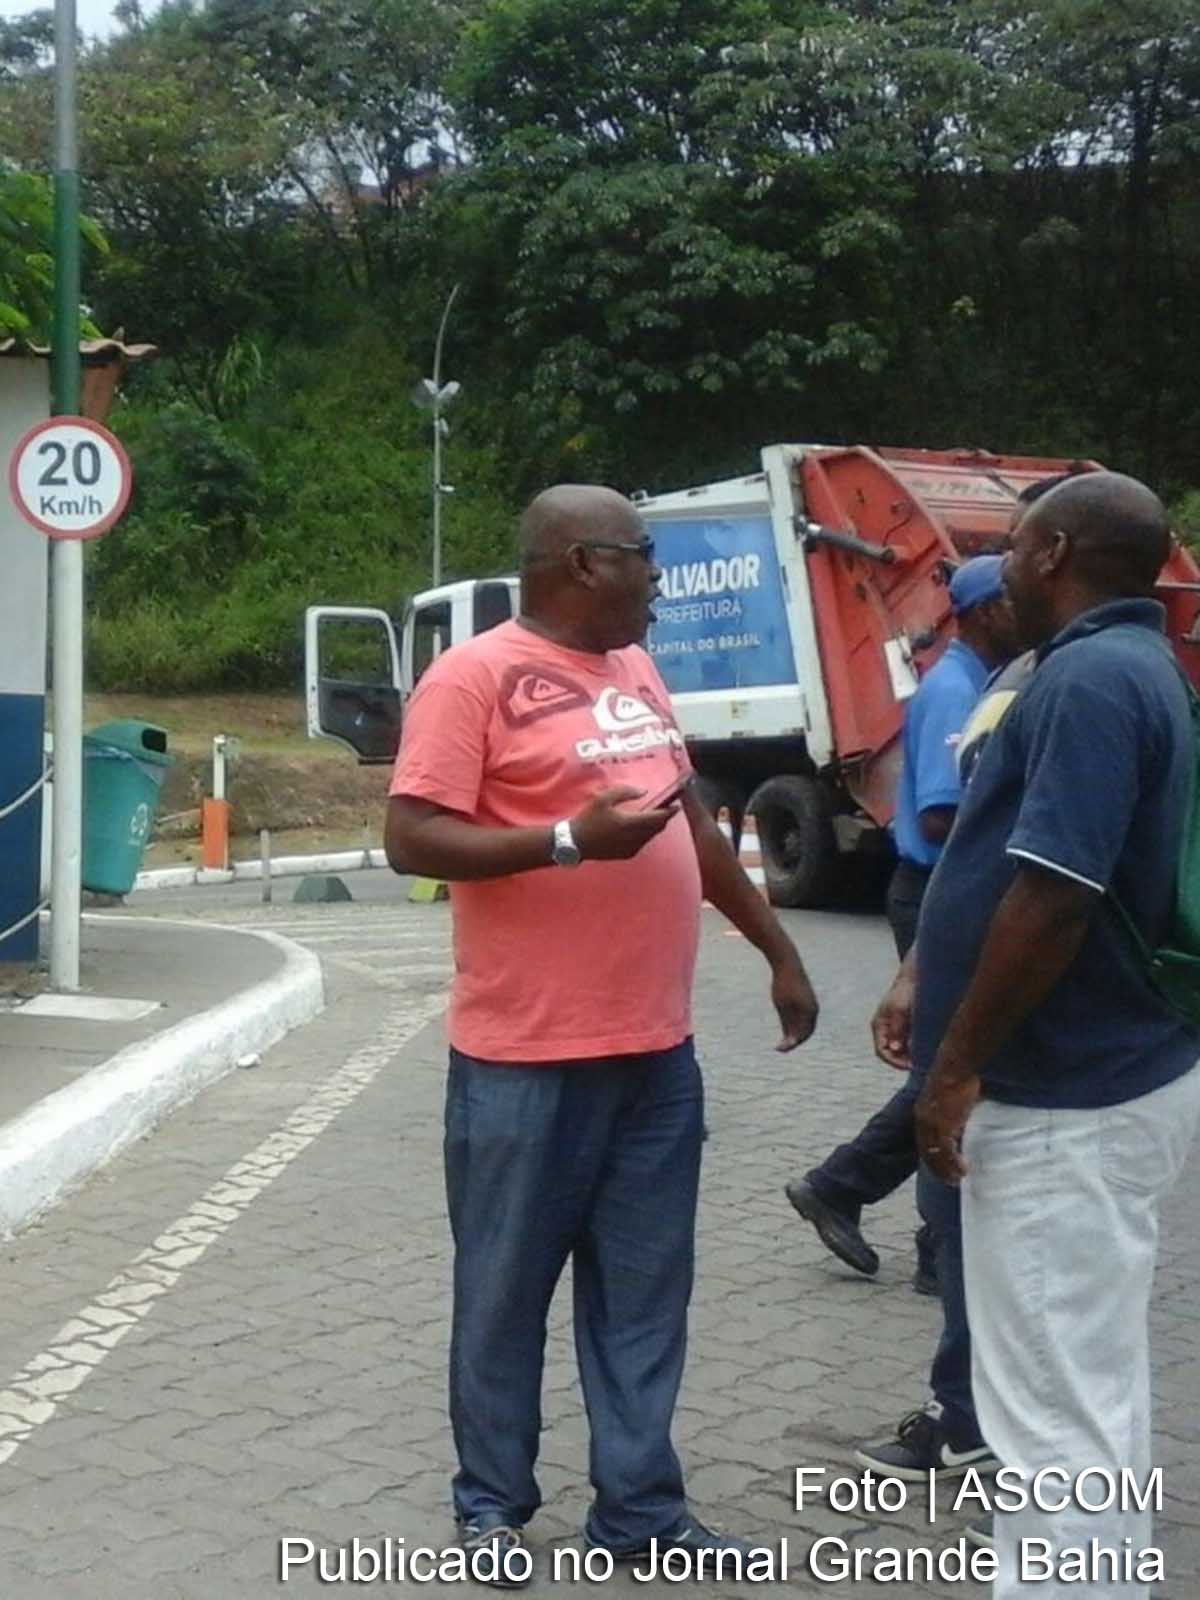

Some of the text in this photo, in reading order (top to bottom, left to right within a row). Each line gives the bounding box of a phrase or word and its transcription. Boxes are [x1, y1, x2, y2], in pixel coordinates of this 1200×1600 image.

[38, 441, 102, 486] 20
[40, 496, 103, 515] Km/h
[657, 553, 761, 599] ALVADOR
[657, 598, 743, 624] PREFEITURA
